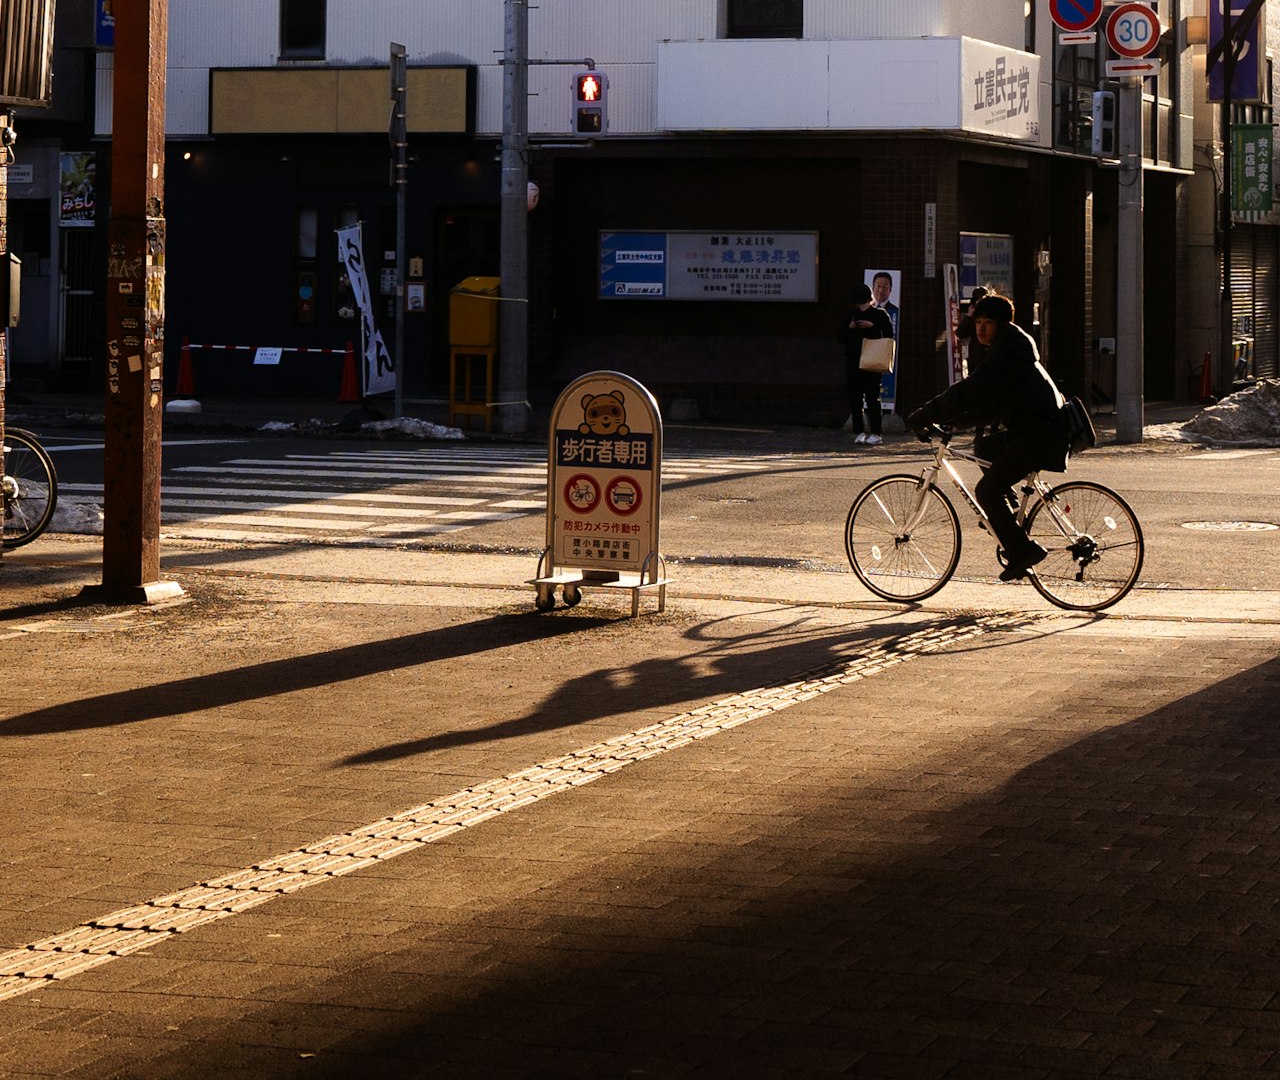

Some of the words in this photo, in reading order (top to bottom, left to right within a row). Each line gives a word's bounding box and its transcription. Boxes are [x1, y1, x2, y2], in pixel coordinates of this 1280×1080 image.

[1119, 18, 1149, 43] 30
[973, 56, 1031, 119] 立憲民主党
[1244, 142, 1256, 178] 商店街
[562, 437, 647, 466] 歩行者専用
[563, 519, 641, 535] 防犯カメラ作動中
[572, 548, 631, 560] 中央警察署
[573, 537, 631, 551] 狸小路商店街
